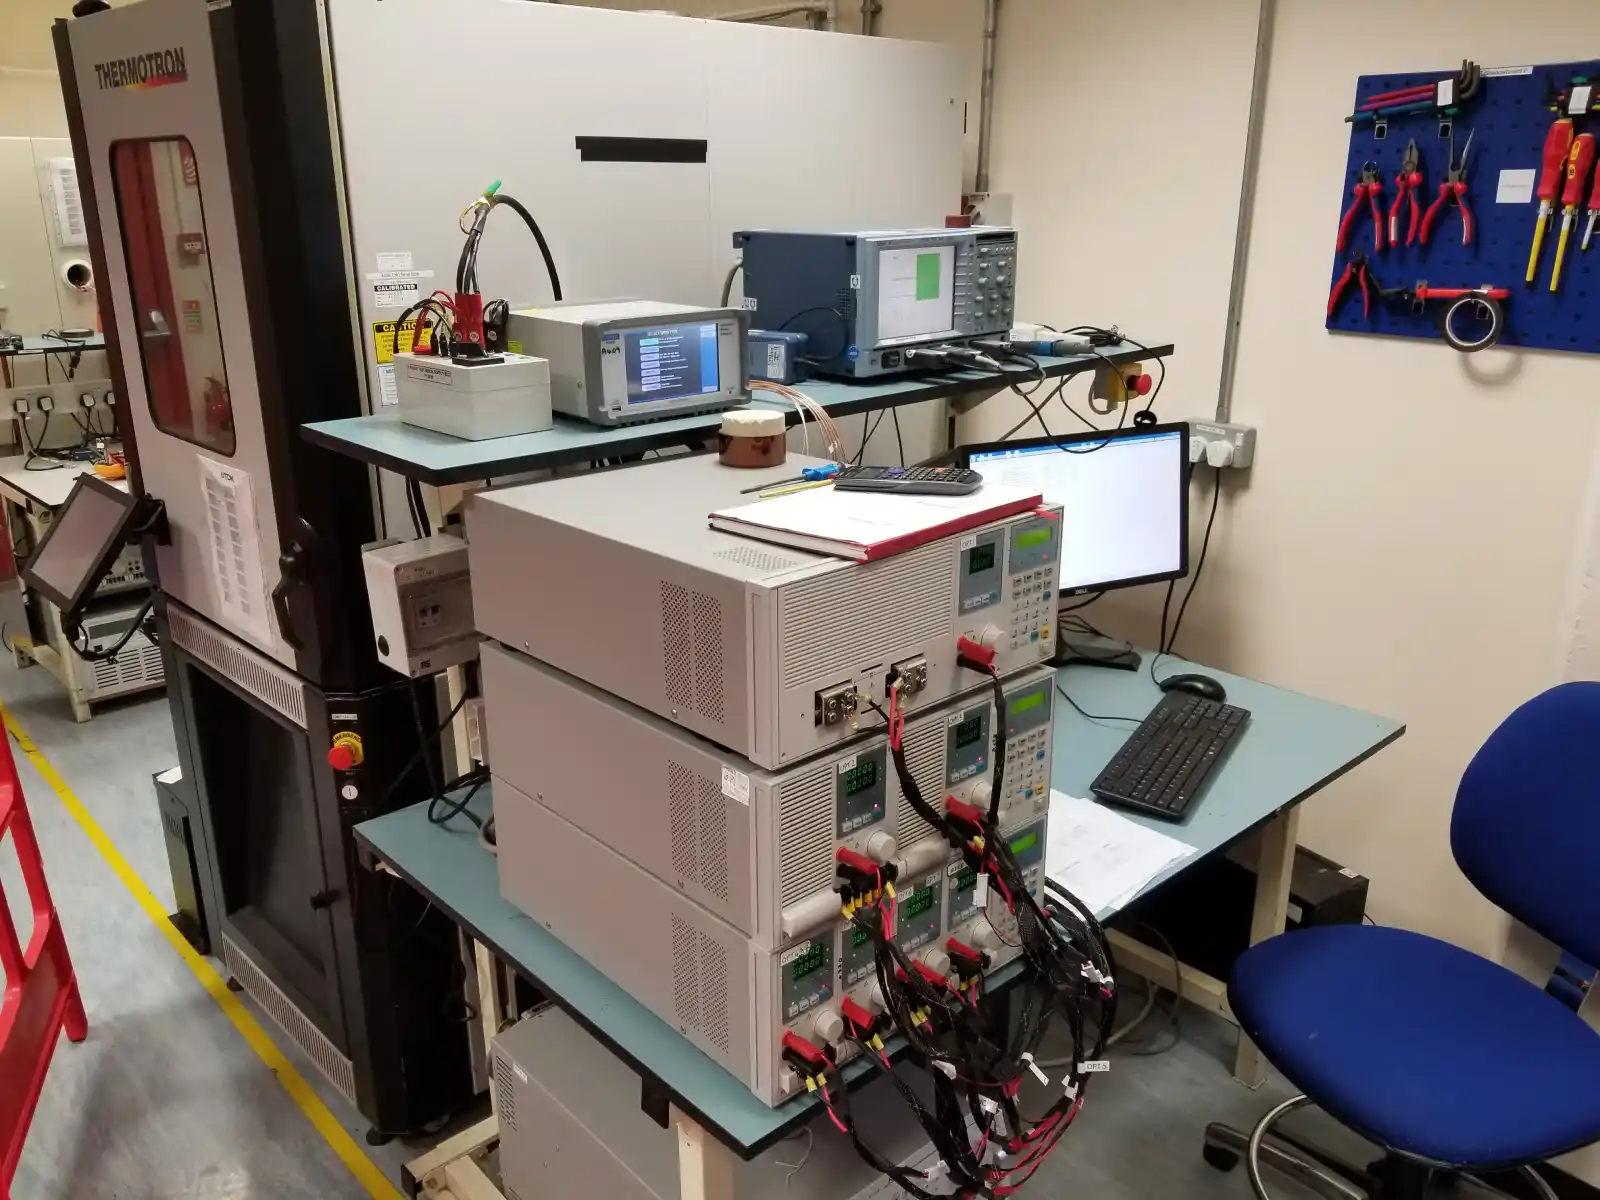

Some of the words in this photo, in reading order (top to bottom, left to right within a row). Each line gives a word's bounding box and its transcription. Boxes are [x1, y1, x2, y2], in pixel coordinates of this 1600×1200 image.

[94, 46, 185, 90] THERMOTRON
[601, 347, 621, 355] A409
[1074, 588, 1089, 596] DELL
